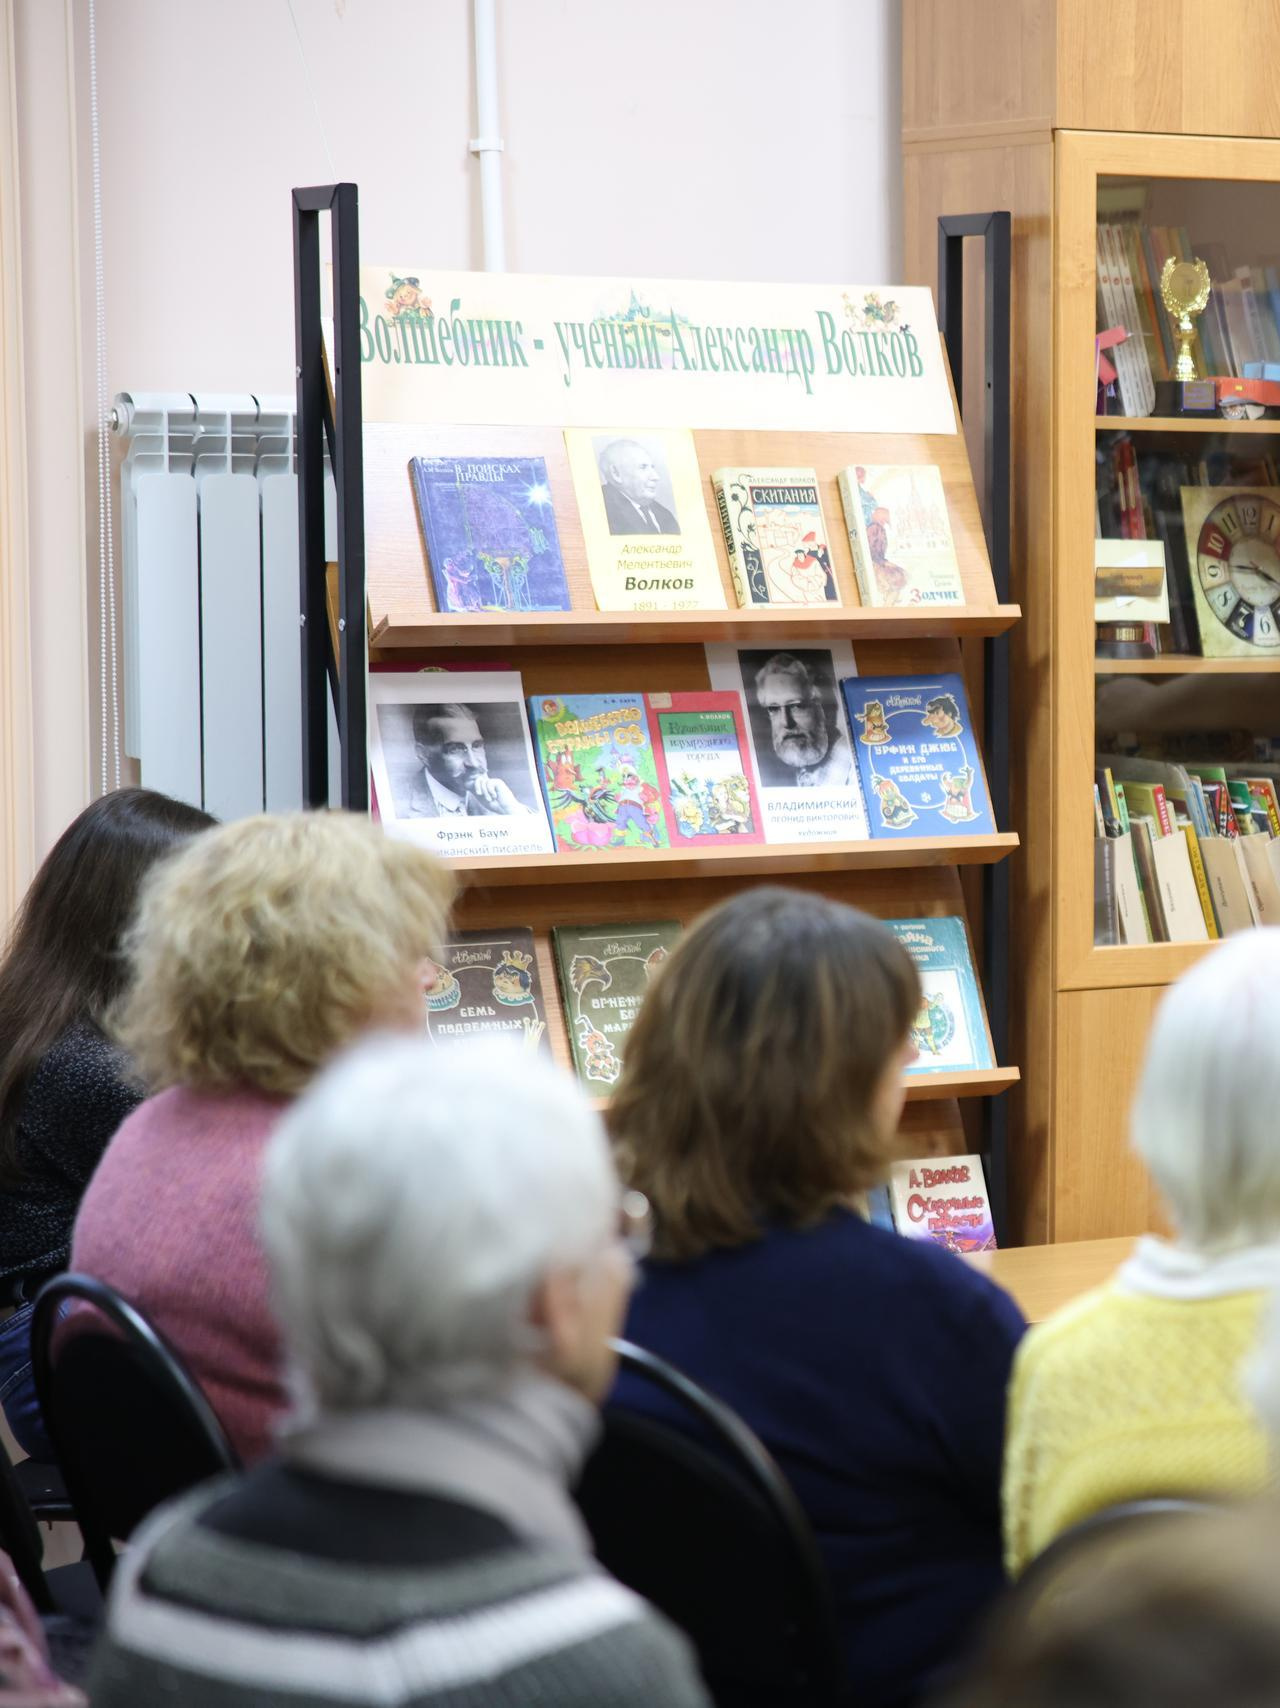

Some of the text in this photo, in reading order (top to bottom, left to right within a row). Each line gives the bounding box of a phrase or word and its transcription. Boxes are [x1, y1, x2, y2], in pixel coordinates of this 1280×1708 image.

[359, 295, 530, 368] Волшебник
[670, 305, 816, 395] Александр
[815, 310, 925, 378] Волков
[454, 463, 521, 474] В ПОИСКАХ
[456, 472, 505, 482] ПРАВДЫ
[752, 488, 818, 504] СКИТАНИЯ
[717, 491, 736, 553] СКИТАНИЯ
[1222, 513, 1237, 533] 11
[1241, 506, 1257, 526] 12
[621, 544, 683, 555] Александр
[1207, 533, 1225, 554] 10
[617, 560, 693, 570] Мелентьевич
[625, 576, 695, 591] Волков
[633, 601, 658, 611] 1891
[1238, 607, 1250, 628] 7
[1259, 615, 1271, 635] 6
[874, 743, 957, 756] УРФИН ДЖЮС
[767, 799, 858, 811] ВЛАДИМИРСКИЙ
[771, 813, 860, 823] ЛЕОНИД ВИКТОРОВИЧ
[437, 828, 509, 842] Фрэнк Баум
[437, 843, 544, 857] иканский писатель
[592, 996, 642, 1009] ОГНЕН
[459, 1006, 496, 1018] СЕМЬ
[438, 1019, 523, 1037] ПОДЗЕМНЫХ
